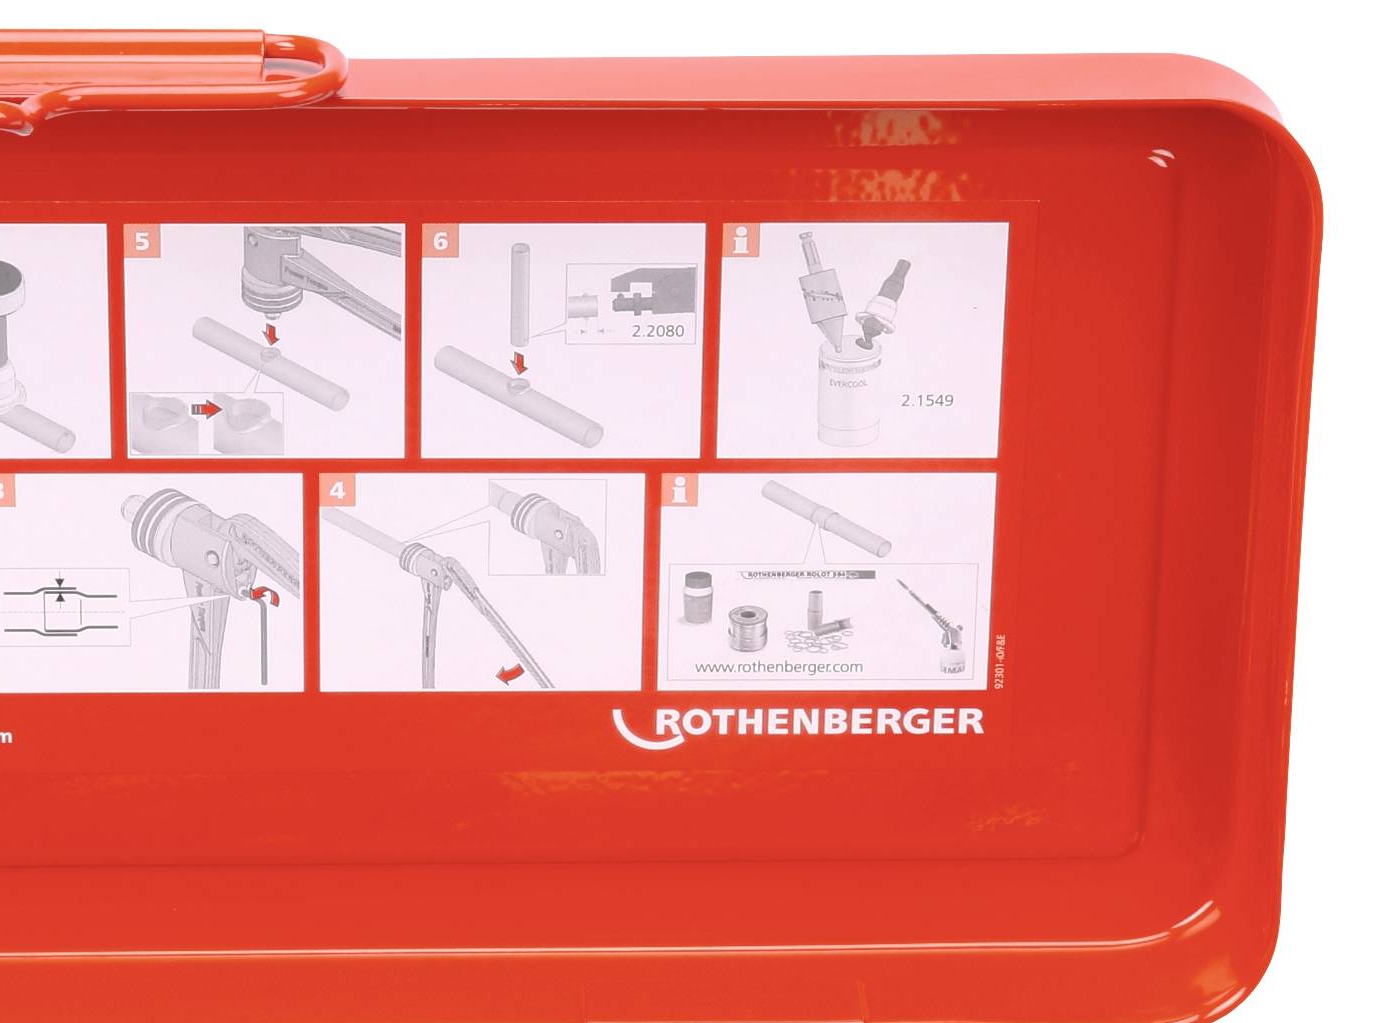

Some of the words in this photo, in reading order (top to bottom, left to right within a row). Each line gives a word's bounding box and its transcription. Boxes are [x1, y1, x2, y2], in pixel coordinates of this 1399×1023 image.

[135, 232, 150, 251] 5
[433, 231, 449, 251] 6
[632, 324, 685, 338] 2.2080
[902, 394, 954, 407] 2.1549
[329, 481, 346, 500] 4
[695, 659, 864, 676] www.rothenberger.com
[655, 708, 984, 736] ROTHENBERGER
